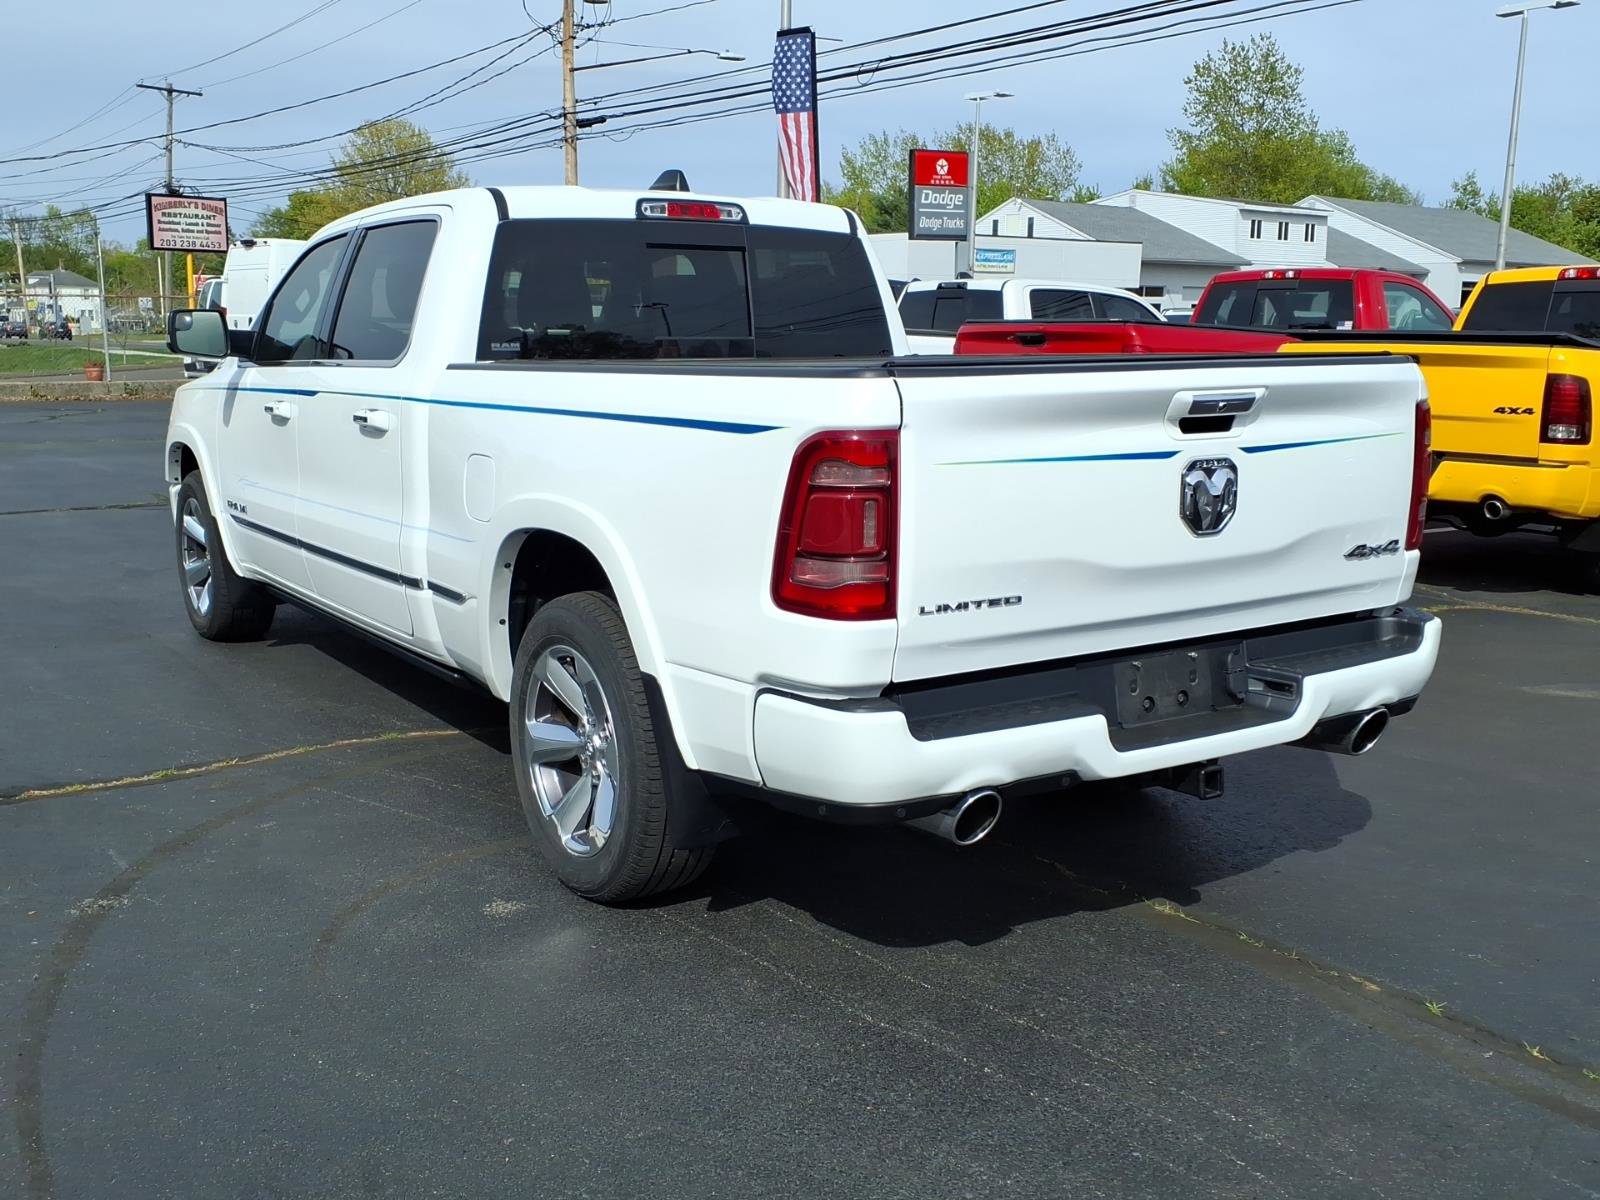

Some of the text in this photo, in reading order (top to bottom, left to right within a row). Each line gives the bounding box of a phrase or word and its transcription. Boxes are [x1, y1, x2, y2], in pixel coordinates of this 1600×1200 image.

[921, 190, 964, 208] Dodge
[154, 201, 224, 216] KIMBERLY'S DINER
[162, 212, 216, 220] RESTAURANT
[919, 216, 964, 231] Dodge Trucks
[160, 238, 222, 249] 203 238 4453
[919, 595, 1023, 616] LIMITED
